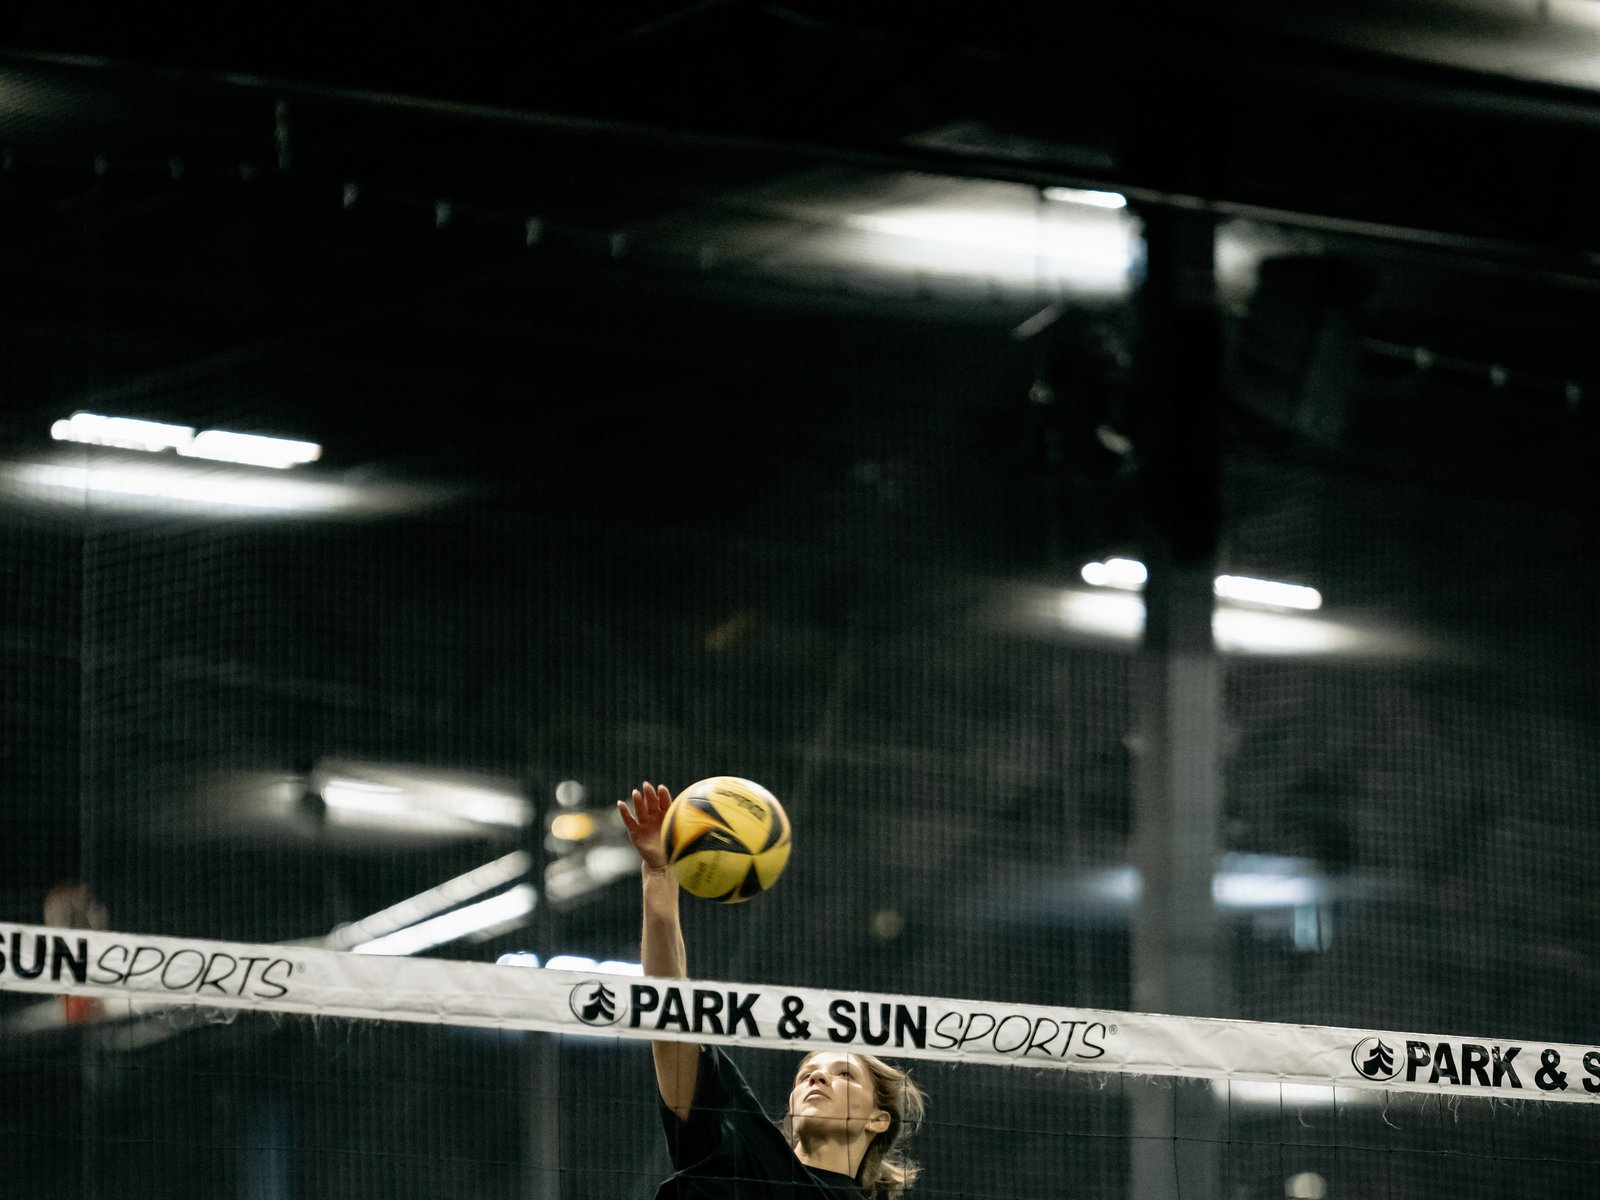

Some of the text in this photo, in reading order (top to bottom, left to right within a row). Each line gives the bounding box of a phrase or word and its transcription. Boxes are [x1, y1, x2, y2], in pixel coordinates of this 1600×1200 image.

[0, 932, 88, 984] UN
[628, 984, 761, 1038] PARK
[777, 995, 812, 1041] &
[1405, 1040, 1523, 1089] PARK
[1534, 1048, 1569, 1092] &
